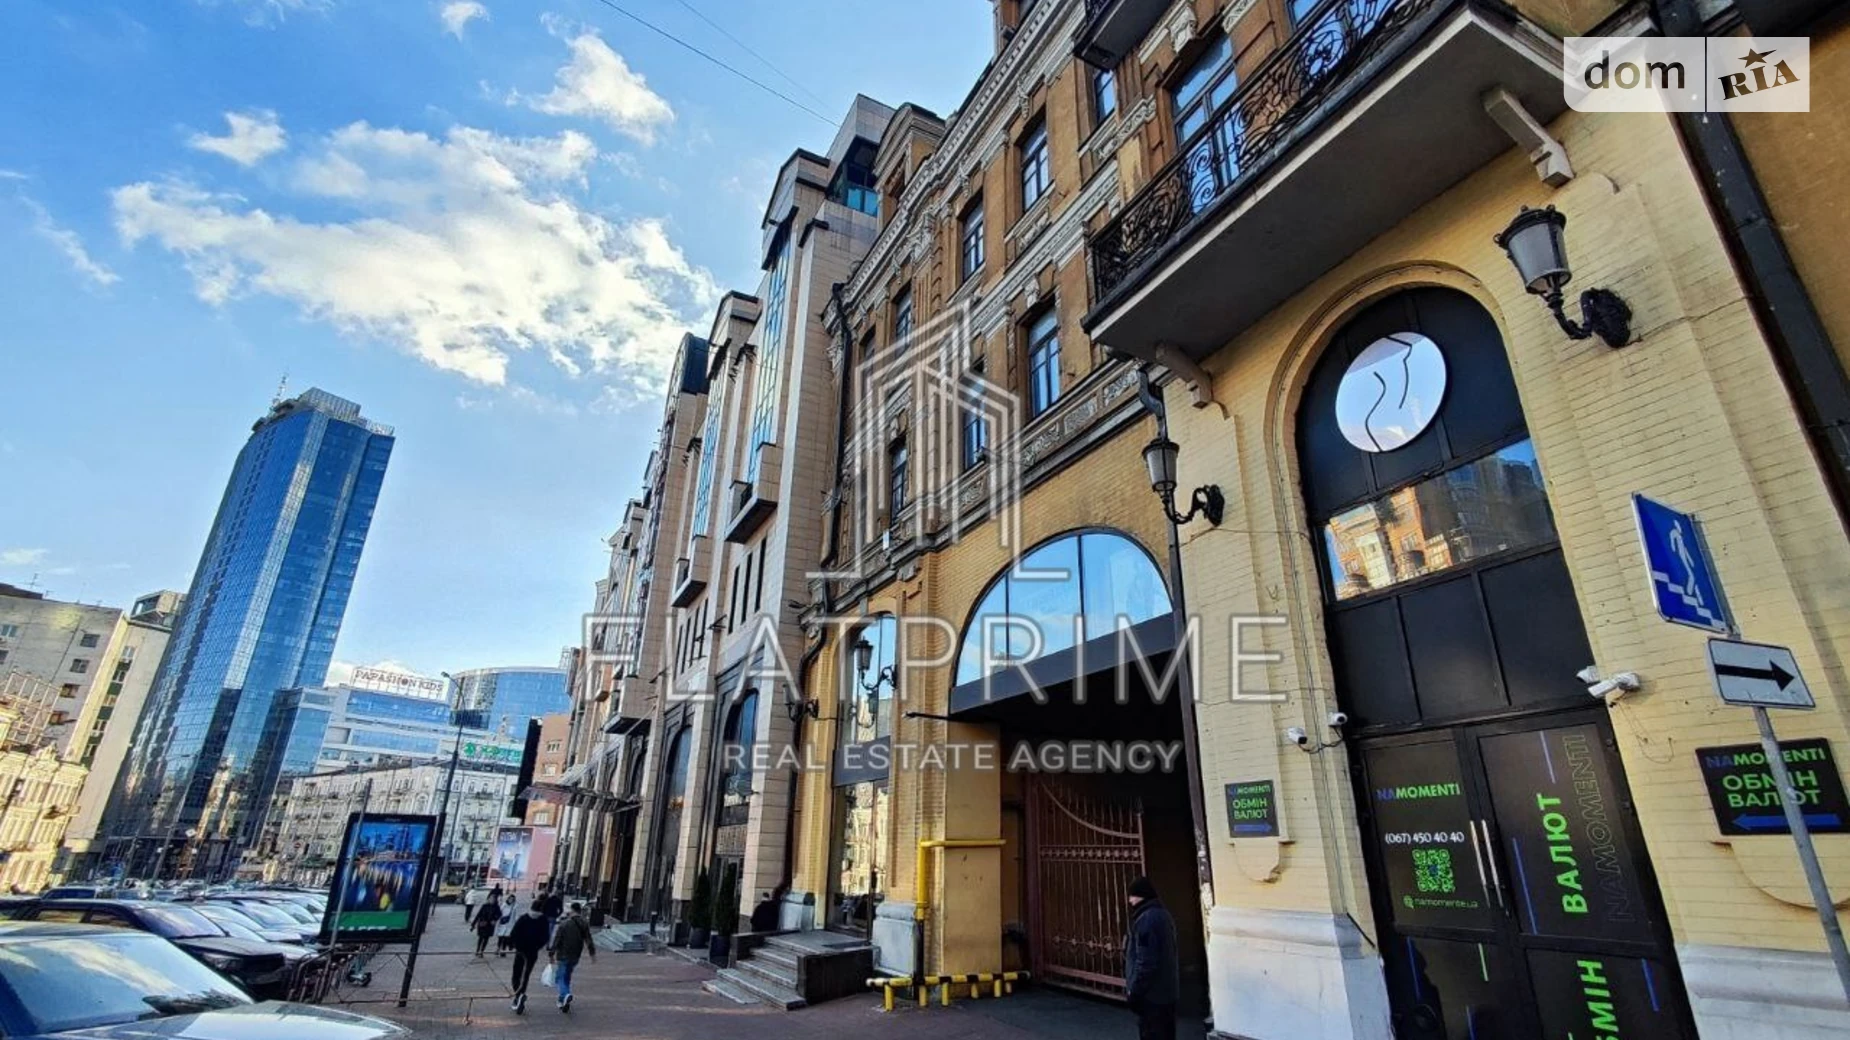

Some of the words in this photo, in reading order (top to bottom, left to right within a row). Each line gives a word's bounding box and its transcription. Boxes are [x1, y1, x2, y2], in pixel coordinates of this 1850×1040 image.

[1705, 748, 1826, 768] NAMOENTI
[1377, 783, 1461, 800] NAMOMENTI
[1232, 798, 1267, 809] ОБМІН
[1234, 809, 1268, 819] ВАЛЮТ
[1385, 833, 1411, 844] (067)
[1413, 832, 1432, 843] 450
[1433, 832, 1448, 843] 40
[1449, 831, 1465, 842] 40
[1536, 793, 1589, 913] ВАЛЮТ
